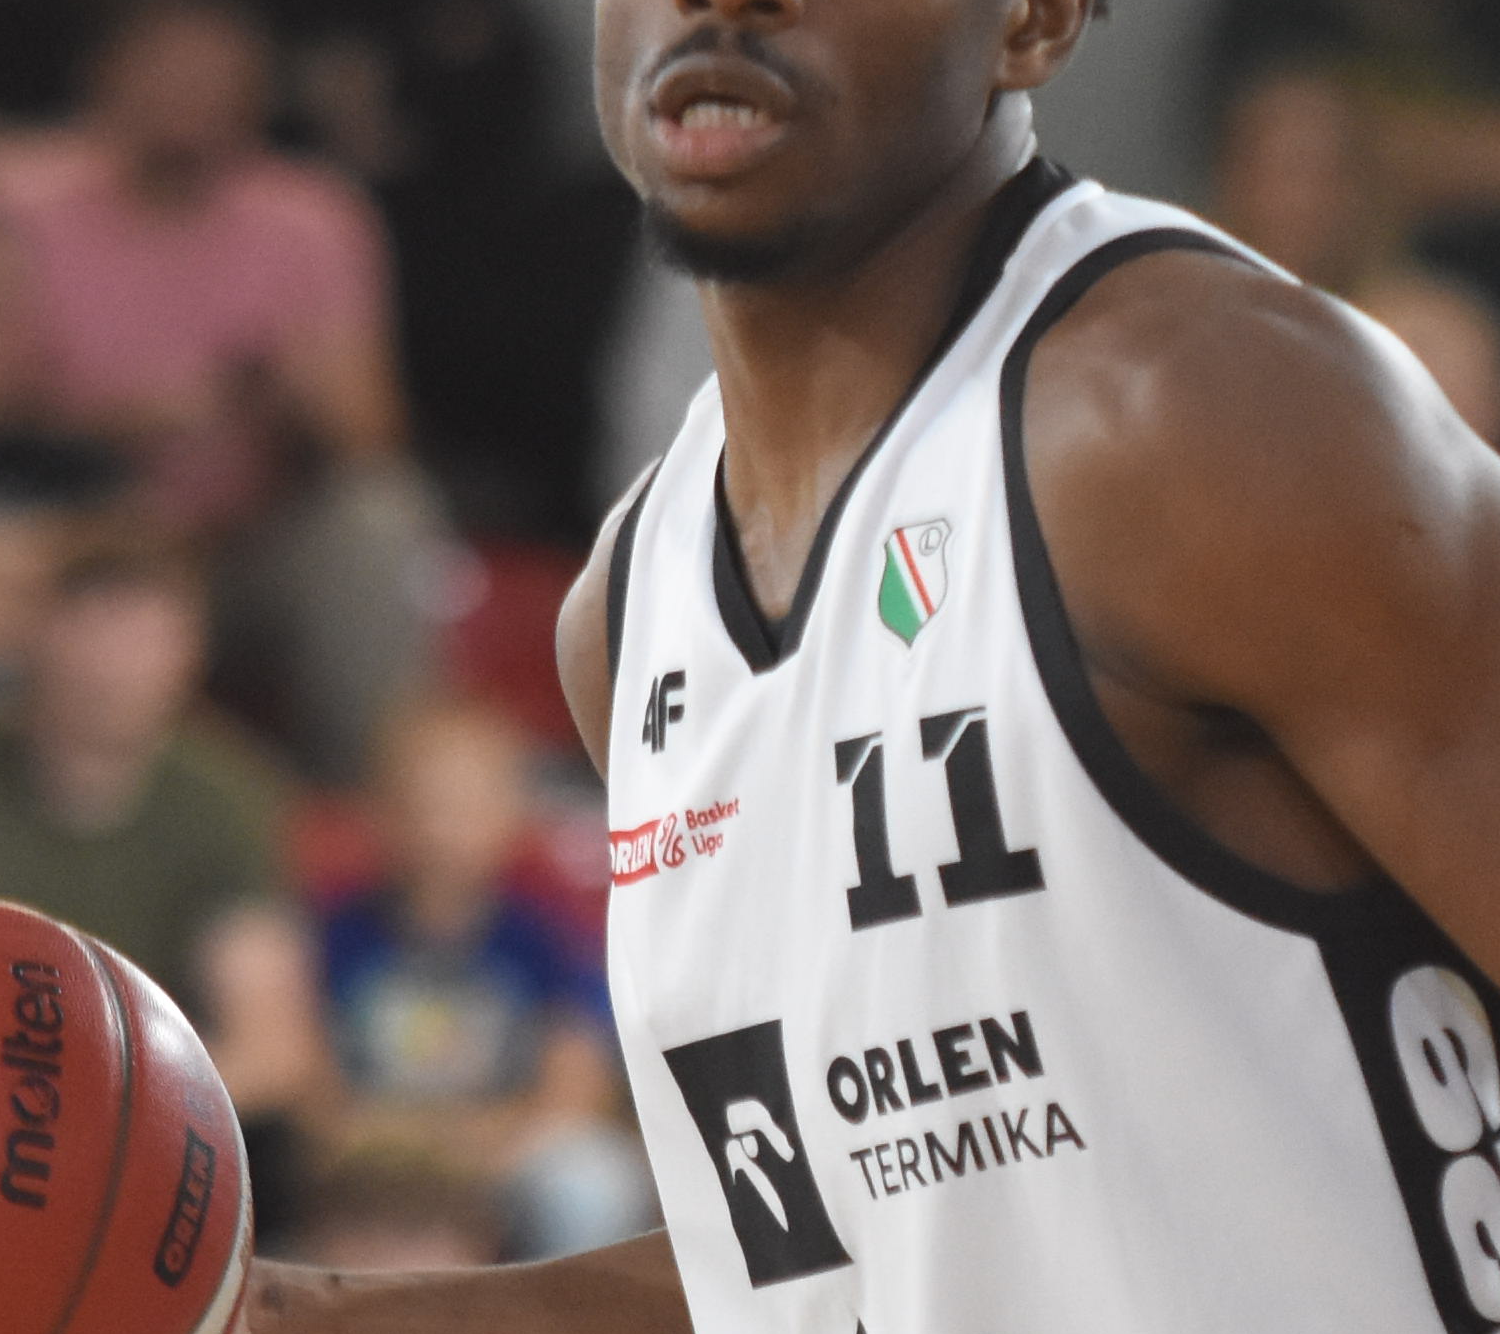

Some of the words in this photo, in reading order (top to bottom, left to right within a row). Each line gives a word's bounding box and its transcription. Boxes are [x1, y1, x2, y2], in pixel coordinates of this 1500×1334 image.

[642, 670, 685, 754] 4F
[685, 798, 740, 830] Basket
[691, 832, 724, 858] Liga
[833, 704, 1047, 933] 11
[0, 961, 64, 1209] molten
[827, 1010, 1044, 1124] ORLEN
[850, 1102, 1088, 1200] TERMIKA
[162, 1139, 214, 1274] ORLEN
